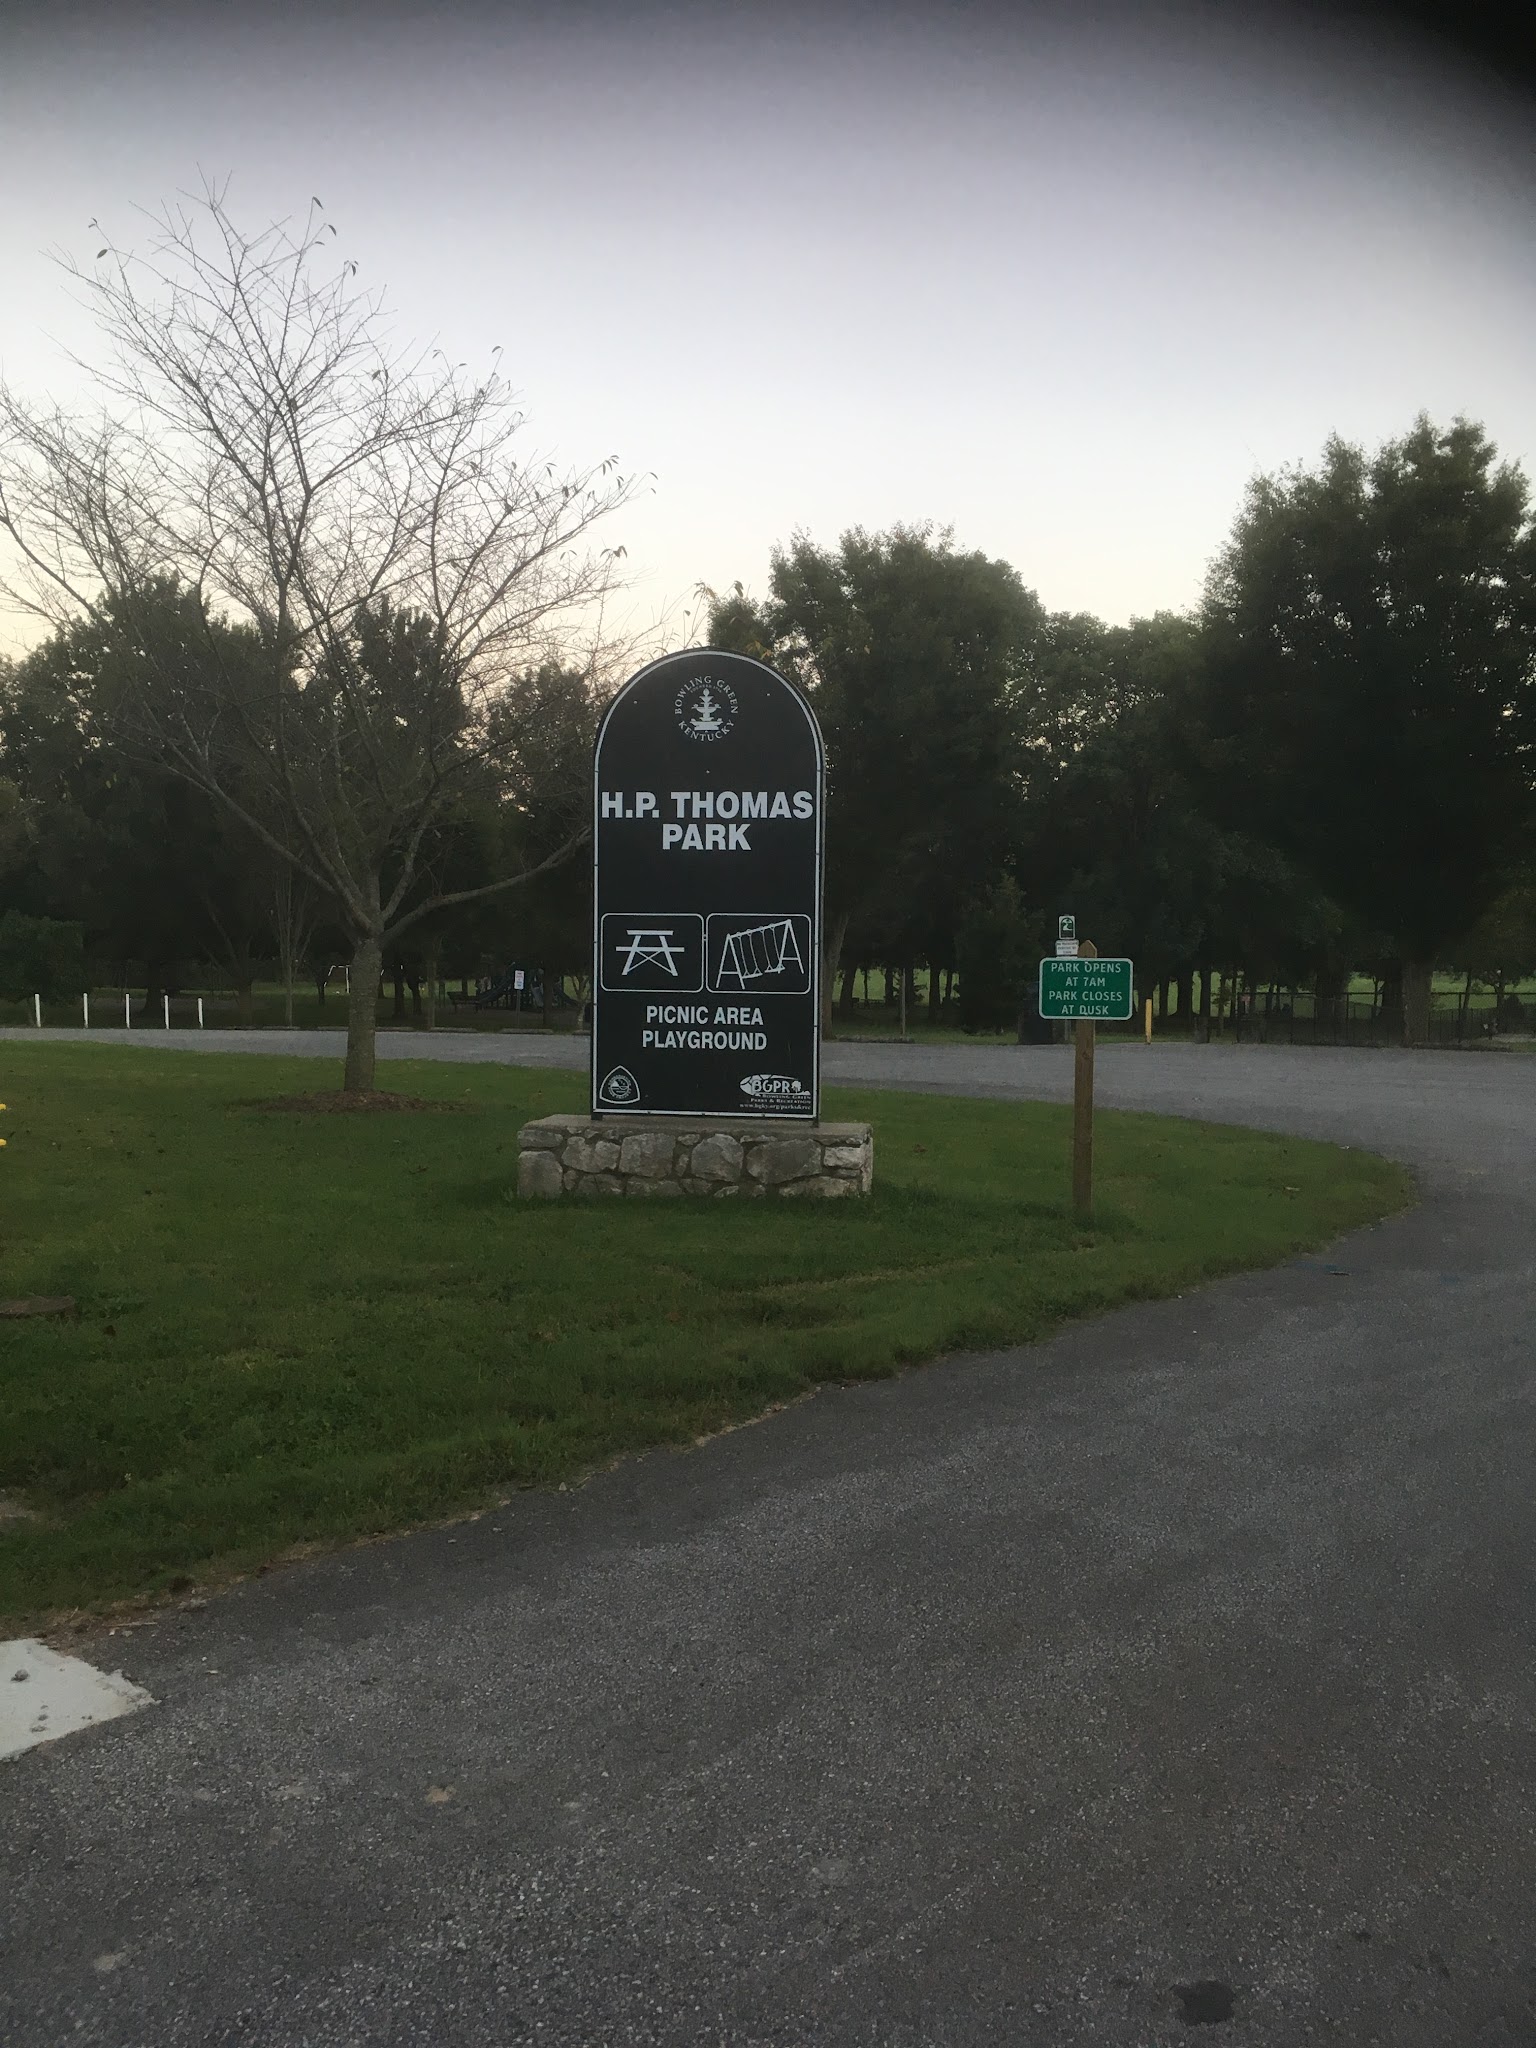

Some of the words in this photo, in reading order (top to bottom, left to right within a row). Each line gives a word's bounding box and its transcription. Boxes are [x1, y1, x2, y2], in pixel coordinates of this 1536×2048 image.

[674, 675, 712, 715] BOWLING
[716, 679, 738, 714] GREEN
[678, 719, 735, 742] KENTUCKY
[601, 791, 660, 819] H.P.
[671, 790, 814, 819] THOMAS
[662, 823, 752, 851] PARK
[1051, 962, 1080, 973] PARK
[1084, 962, 1122, 973] OPENS
[1065, 976, 1079, 987] AT
[1083, 977, 1106, 987] 7AM
[1049, 990, 1078, 1001] PARK
[1082, 991, 1123, 1001] CLOSES
[646, 1005, 709, 1025] PICNIC
[713, 1007, 764, 1025] AREA
[1061, 1005, 1074, 1014] AT
[1079, 1005, 1109, 1015] DUSK
[642, 1030, 768, 1051] PLAYGROUND
[752, 1080, 791, 1093] BGPR
